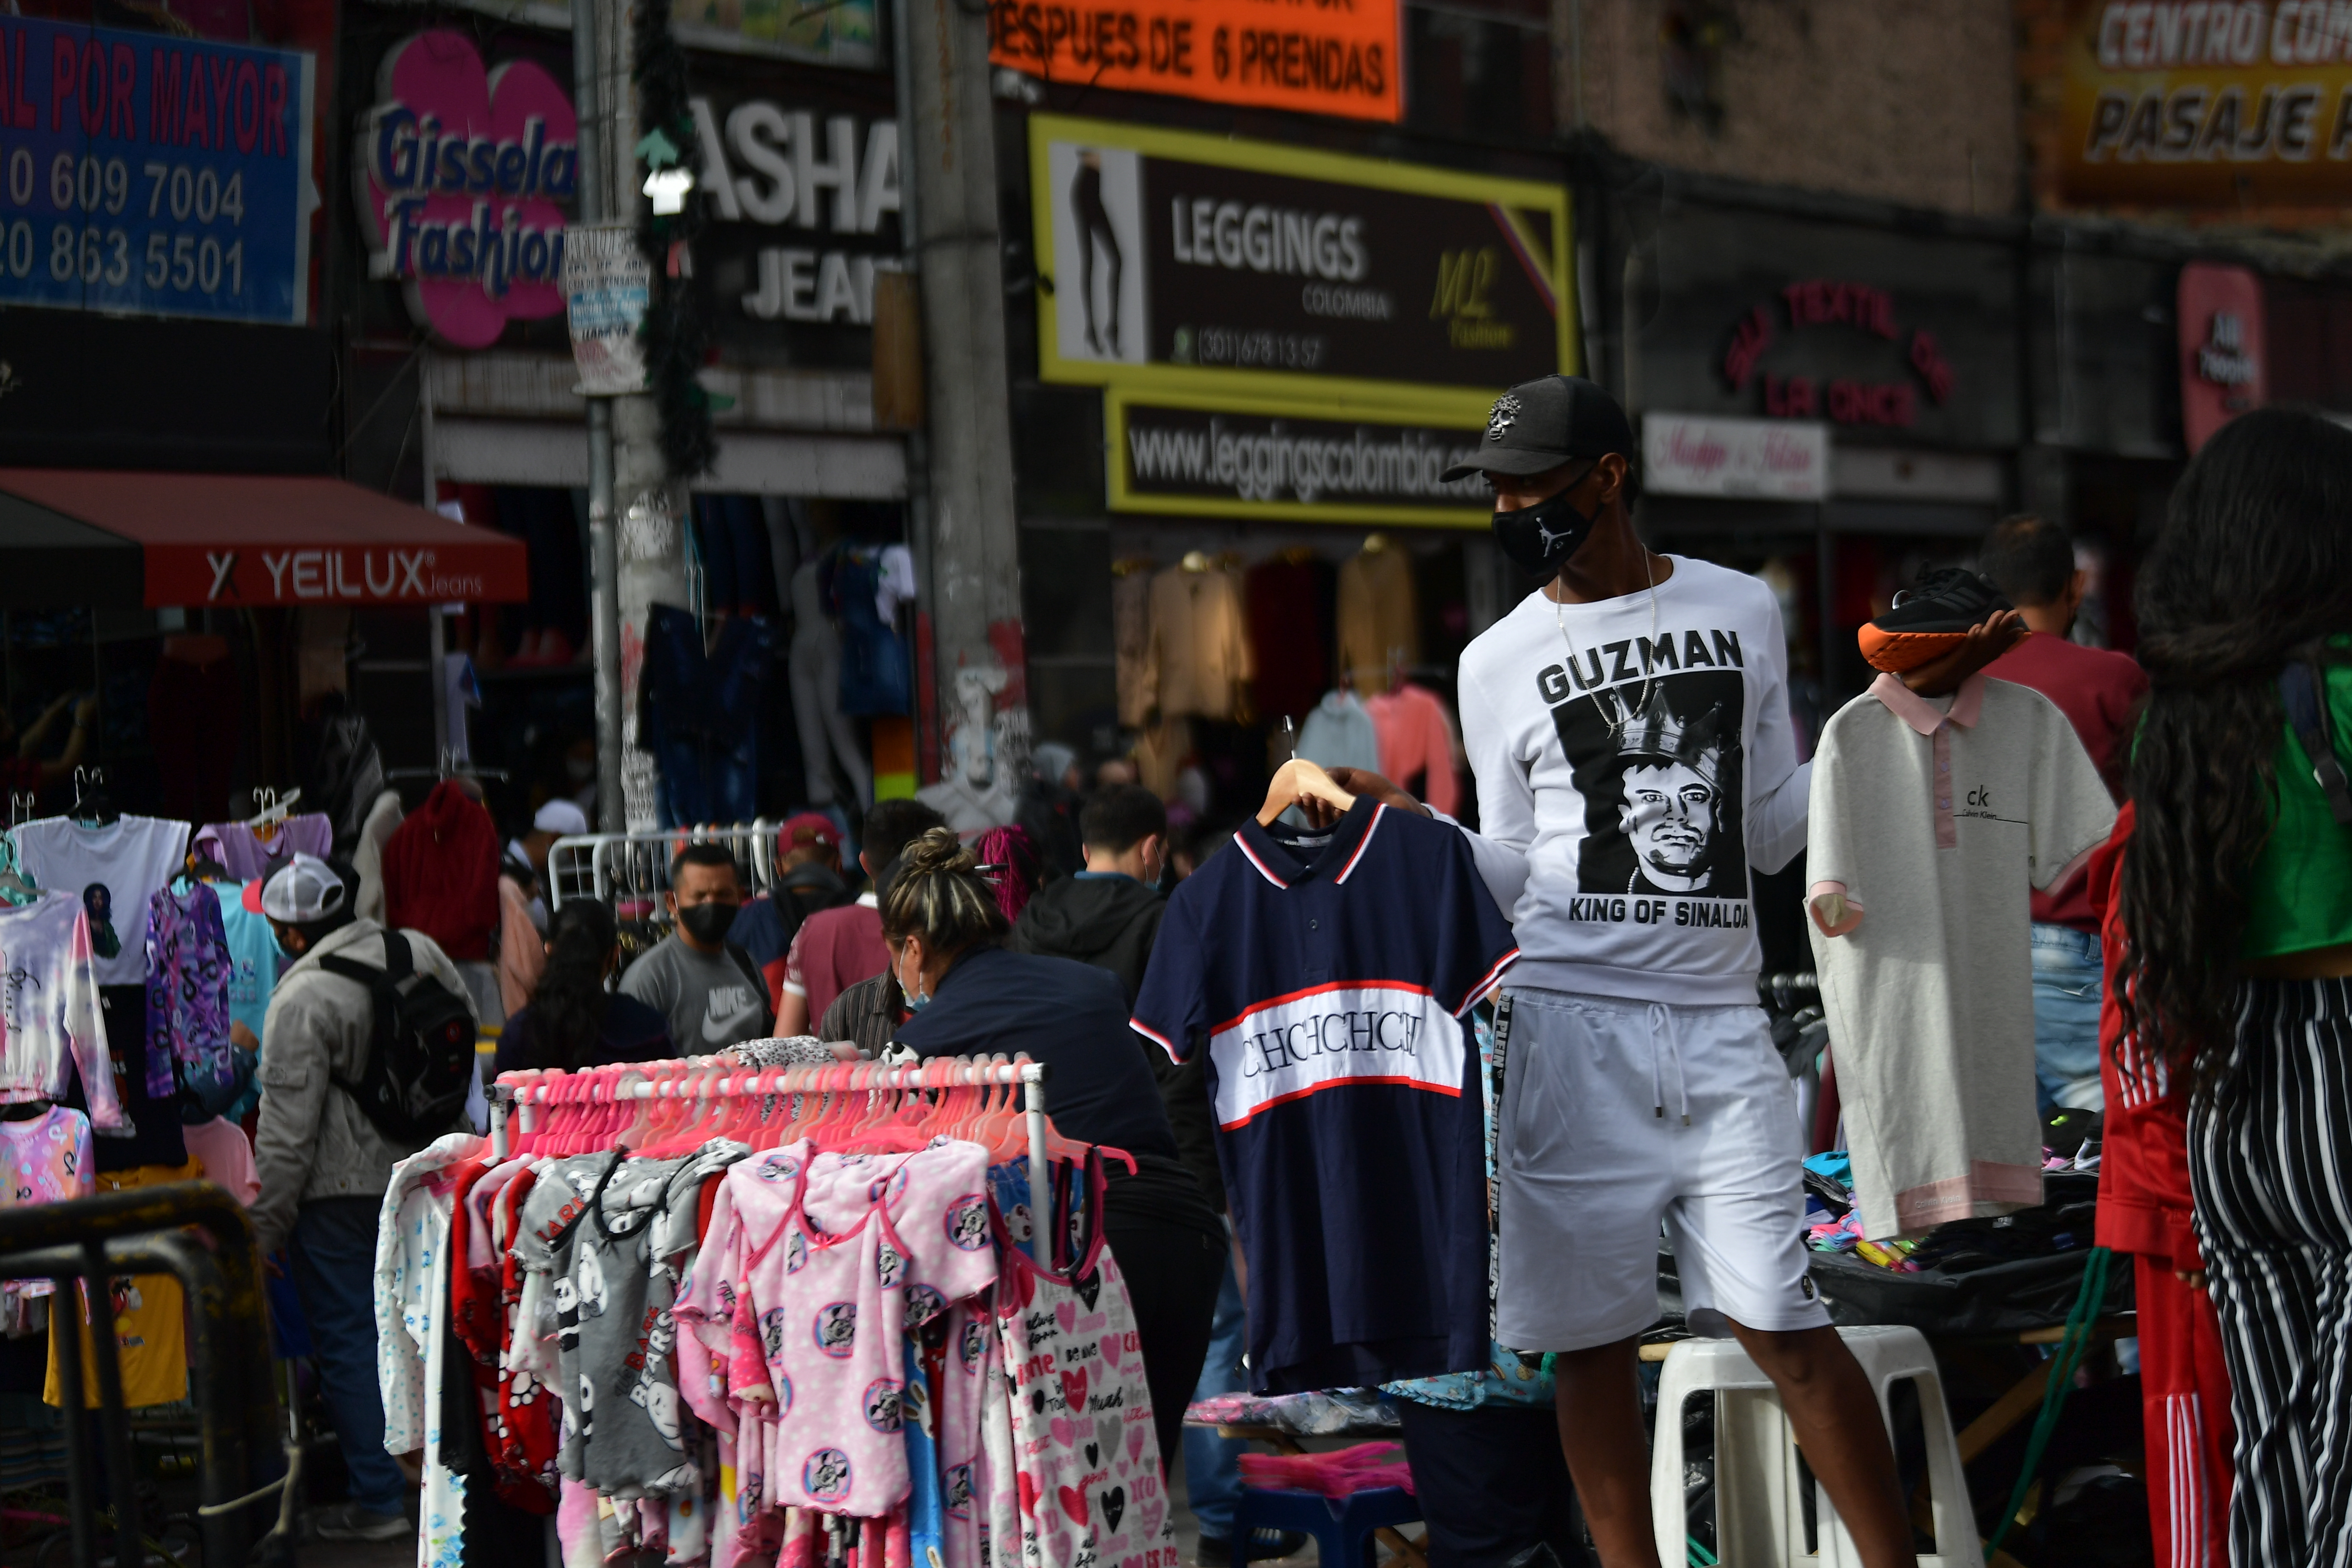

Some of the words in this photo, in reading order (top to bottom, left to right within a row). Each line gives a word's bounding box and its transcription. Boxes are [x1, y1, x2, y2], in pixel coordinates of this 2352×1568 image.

[1150, 17, 1192, 76] DE
[1212, 25, 1229, 80] 6
[1240, 30, 1385, 96] PRENDAS
[2096, 1, 2262, 68] CENTRO
[51, 34, 136, 142] POR
[150, 46, 288, 158] MAYOR
[2081, 83, 2323, 163] PASAJE
[369, 102, 577, 199] Gissela
[50, 154, 128, 216] 609
[144, 164, 244, 227] 7004
[0, 220, 33, 279] 0
[50, 224, 129, 289] 863
[144, 234, 242, 297] 5501
[1172, 196, 1364, 282] LEGGINGS
[1303, 281, 1394, 321] COLOMBIA
[1535, 629, 1744, 705] GUZMAN
[1967, 784, 1989, 807] ck
[1980, 811, 1997, 820] Klein
[1568, 897, 1626, 923] KING
[1633, 900, 1666, 925] OF
[1674, 902, 1748, 929] SINALOA
[708, 984, 748, 1017] NIKE
[1492, 1019, 1509, 1069] PLEIN
[625, 1305, 660, 1372] BARE
[629, 1311, 676, 1409] BEARS
